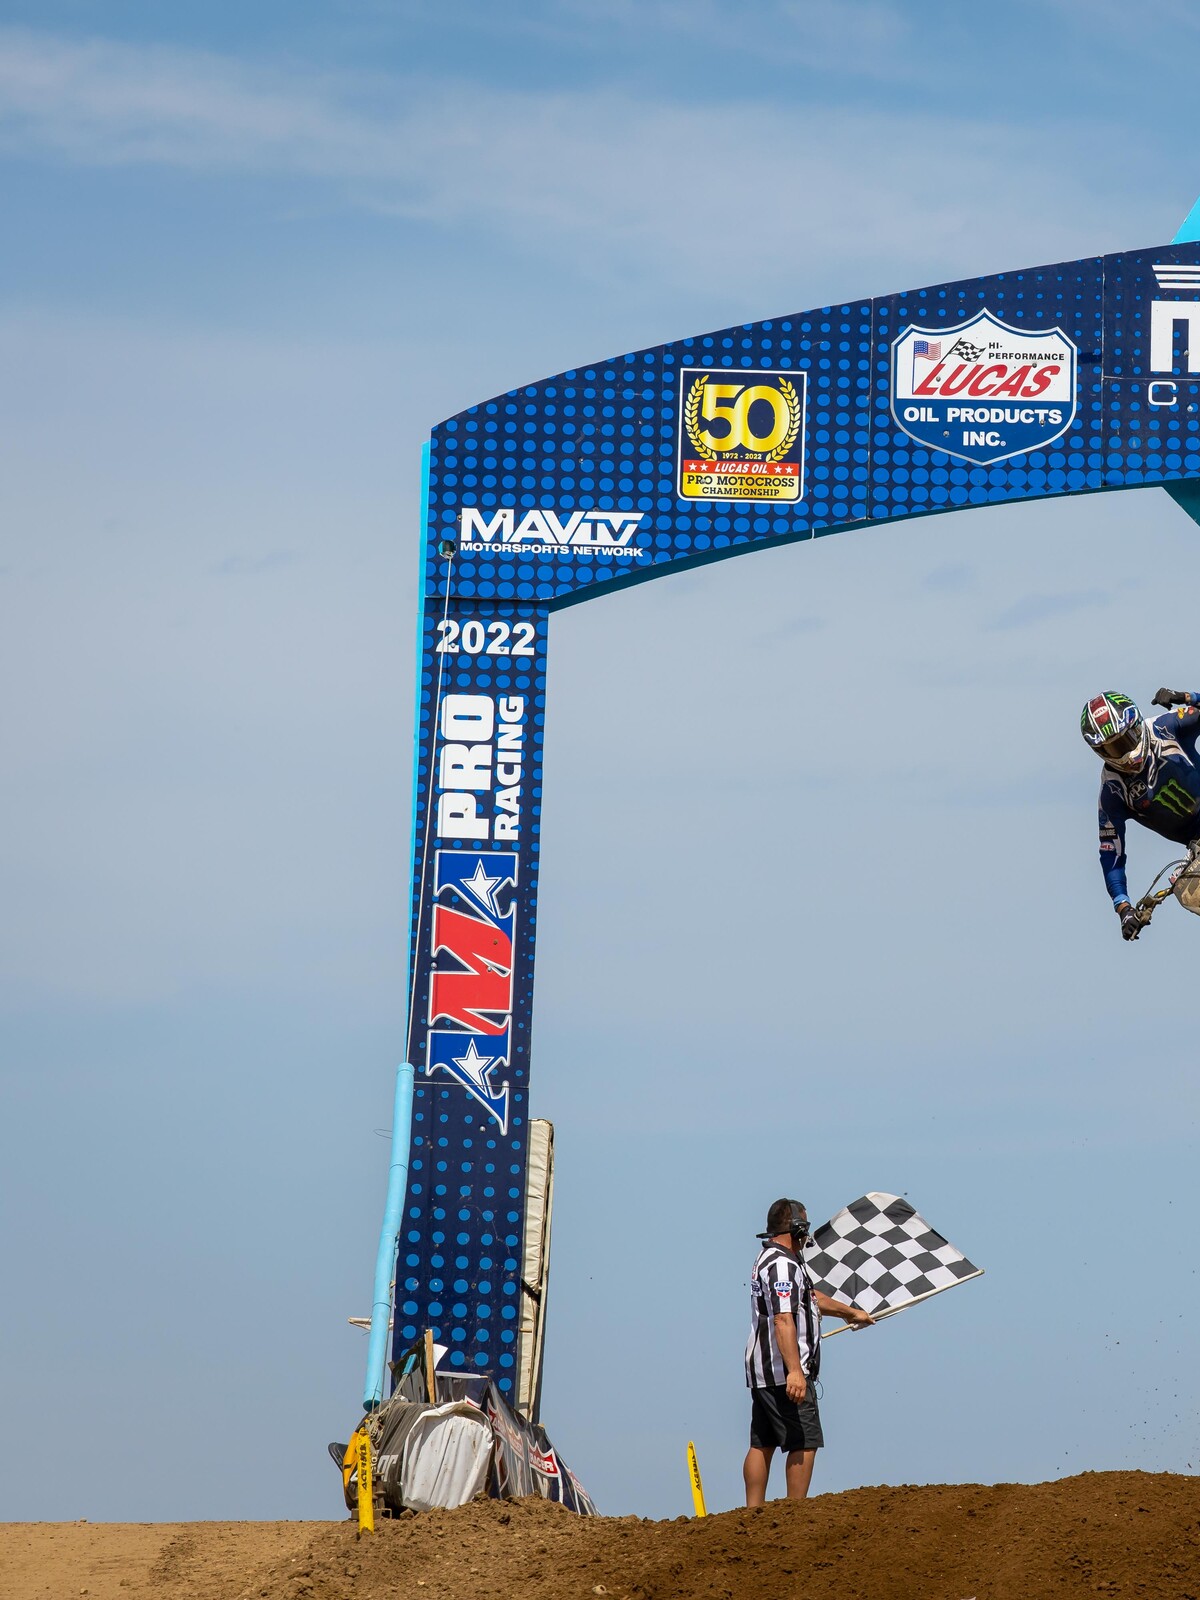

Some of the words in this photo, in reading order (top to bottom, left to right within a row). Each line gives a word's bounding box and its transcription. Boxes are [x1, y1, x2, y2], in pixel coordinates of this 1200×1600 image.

[988, 353, 1065, 361] PERFORMANCE
[912, 364, 1061, 397] LUCAS
[699, 384, 792, 452] 50
[904, 407, 939, 422] OIL
[947, 408, 1063, 424] PRODUCTS
[963, 431, 1001, 447] INC.
[687, 475, 713, 485] PRO
[717, 476, 795, 487] MOTOCROSS
[715, 463, 750, 473] LUCAS
[751, 464, 768, 474] OIL
[702, 487, 780, 496] CHAMPIONSHIP
[461, 508, 645, 546] MAVTV
[460, 542, 570, 555] MOTORSPORTS
[573, 545, 643, 557] NETWORK
[435, 620, 535, 656] 2022
[437, 694, 495, 840] PRO
[494, 697, 525, 840] RACING
[426, 849, 519, 1137] AMA
